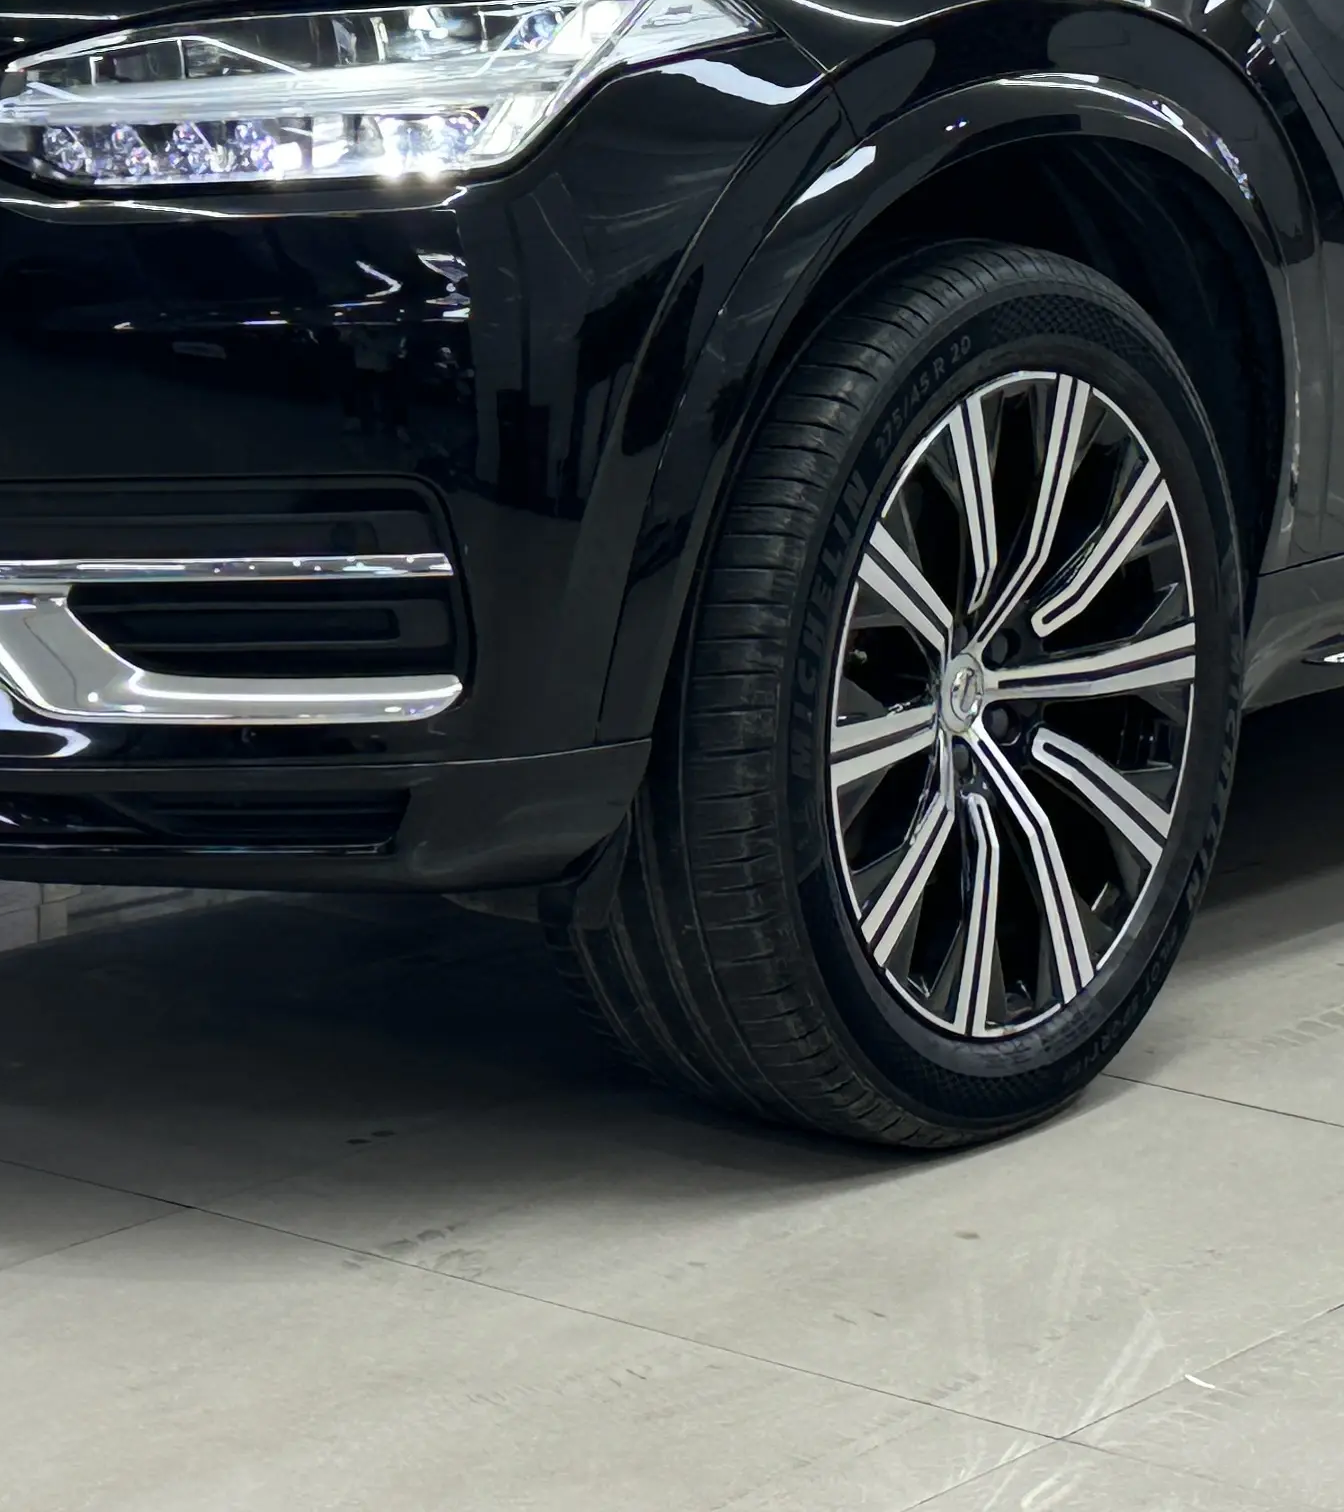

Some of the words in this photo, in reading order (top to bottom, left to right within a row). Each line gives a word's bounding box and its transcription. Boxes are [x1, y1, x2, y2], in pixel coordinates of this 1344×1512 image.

[874, 371, 933, 461] 275/45
[930, 358, 947, 379] R
[949, 334, 972, 364] 20
